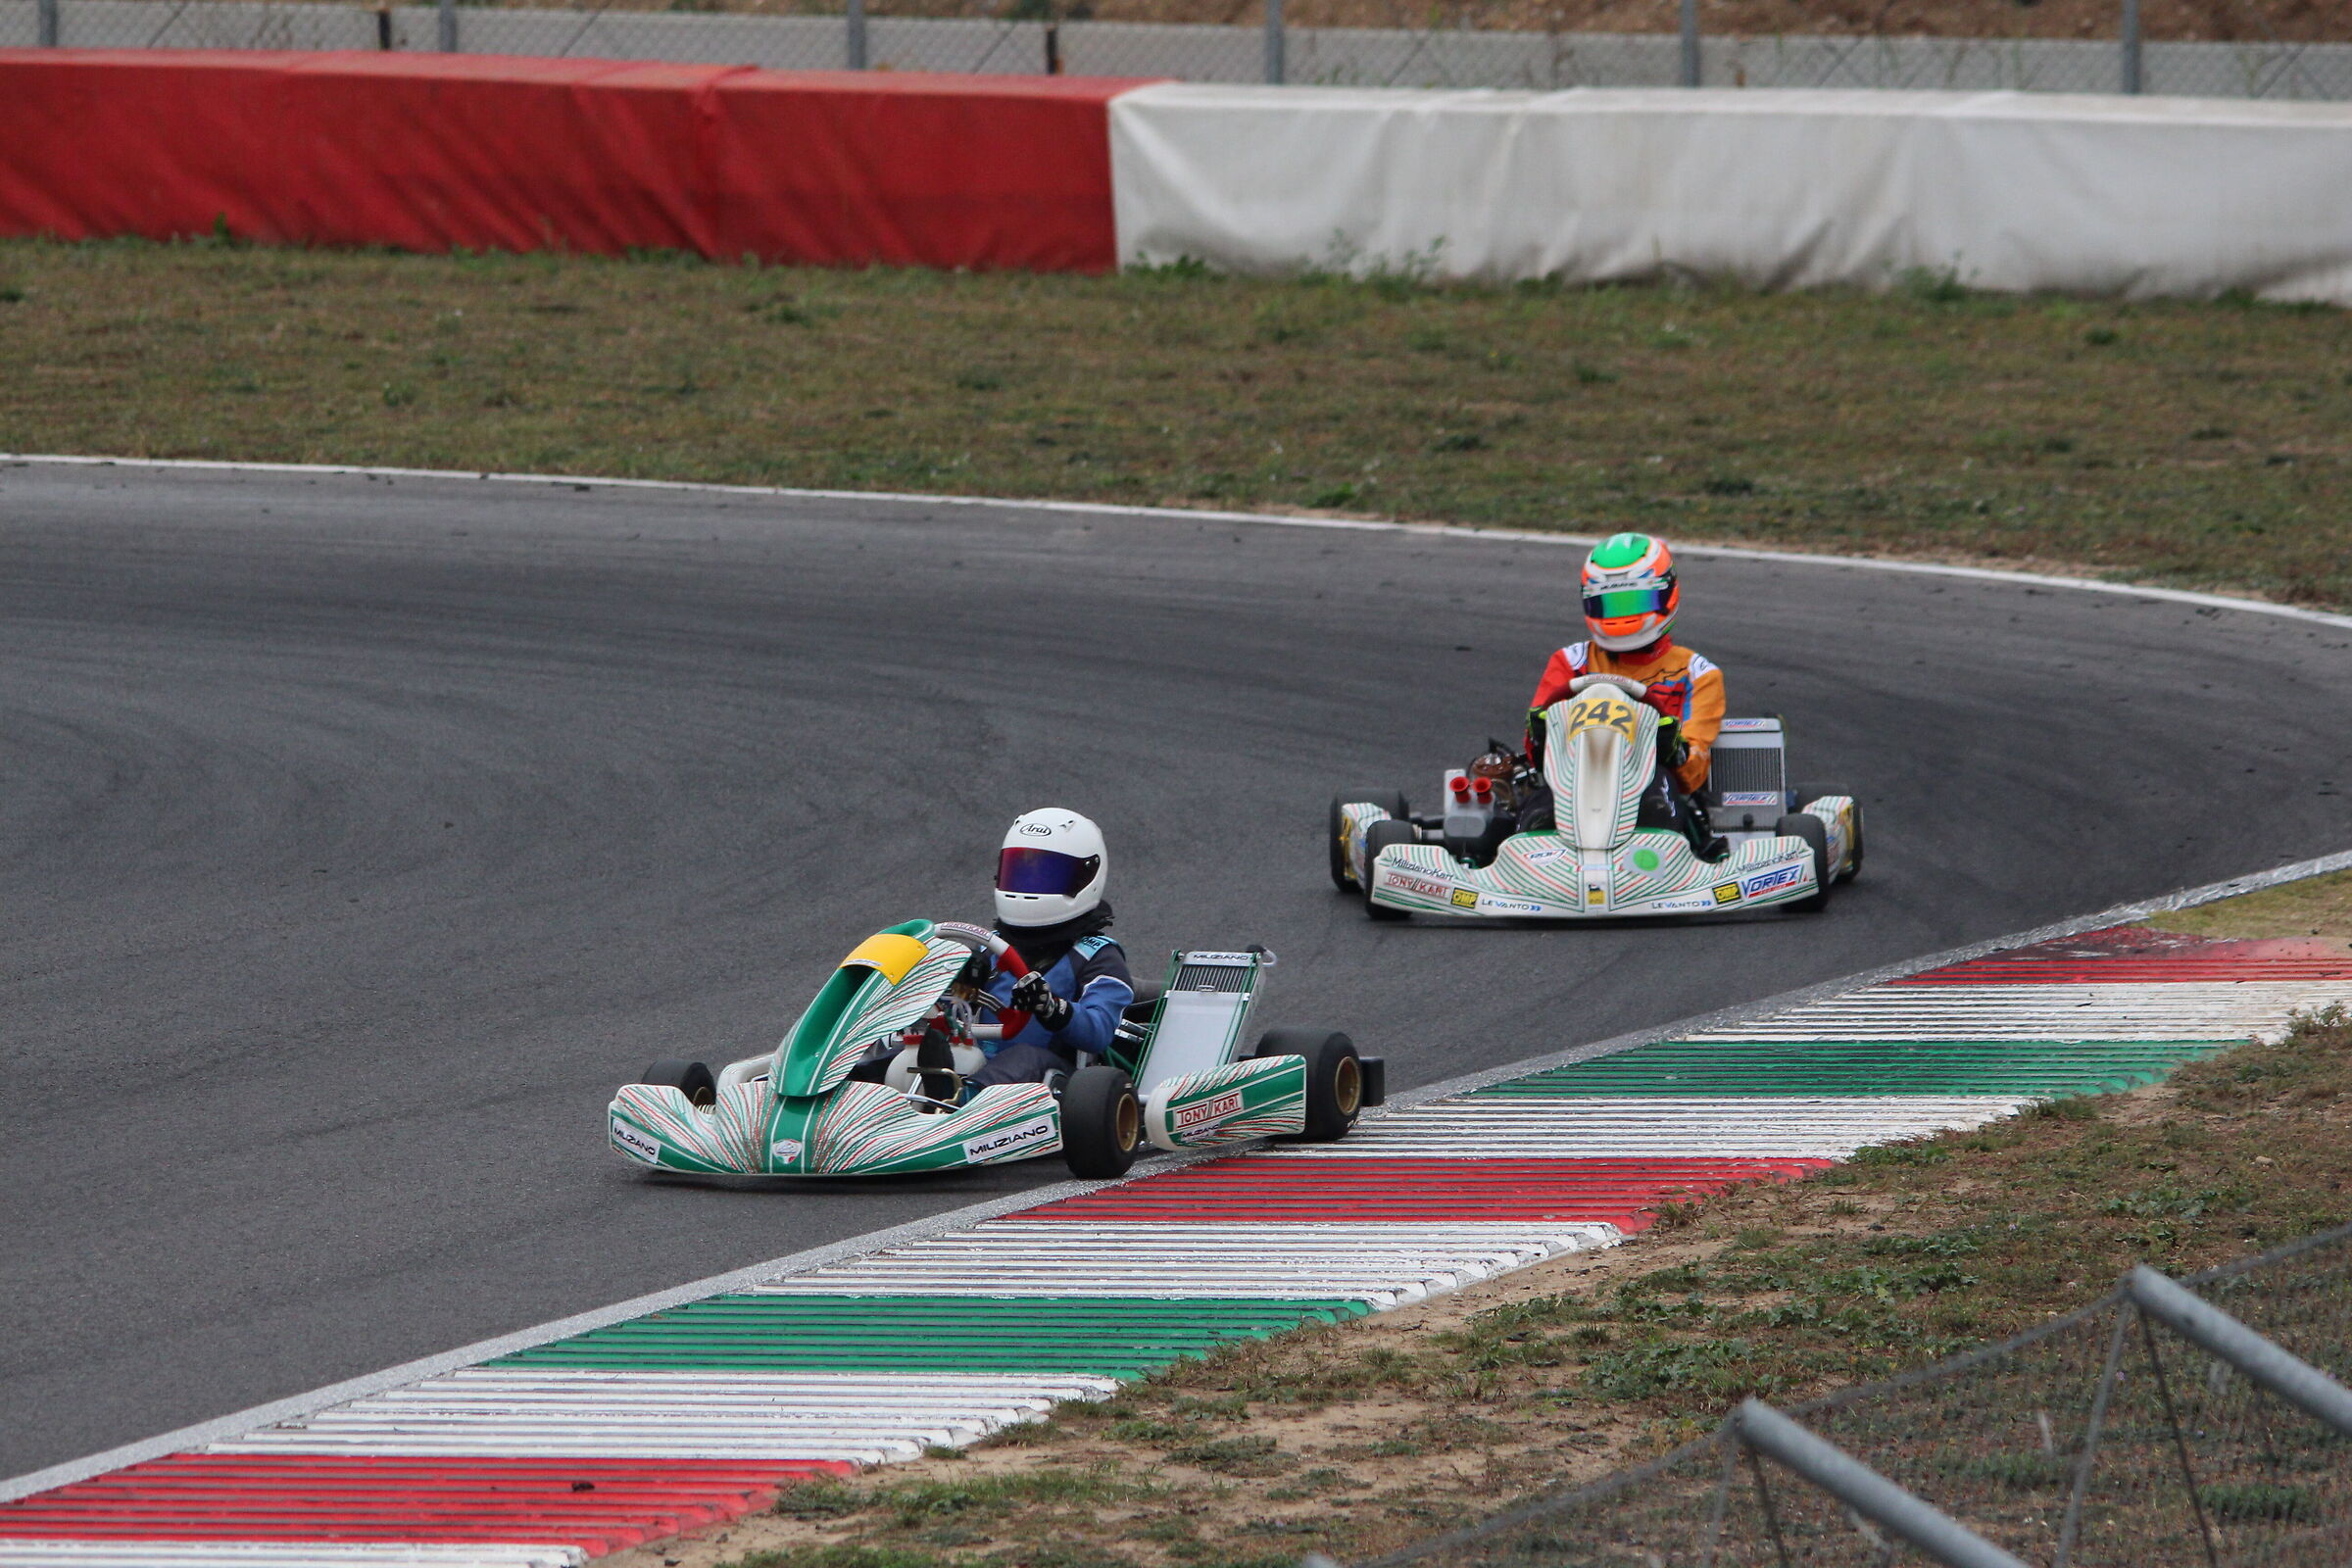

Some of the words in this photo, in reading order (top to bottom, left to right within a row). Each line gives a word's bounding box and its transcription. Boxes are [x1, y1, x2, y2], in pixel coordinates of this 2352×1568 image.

[1570, 701, 1633, 735] 242
[1025, 824, 1049, 834] Arai
[1740, 864, 1801, 898] VORTEX
[613, 1127, 657, 1156] MILIZIANO
[969, 1125, 1049, 1155] MILIZIANO
